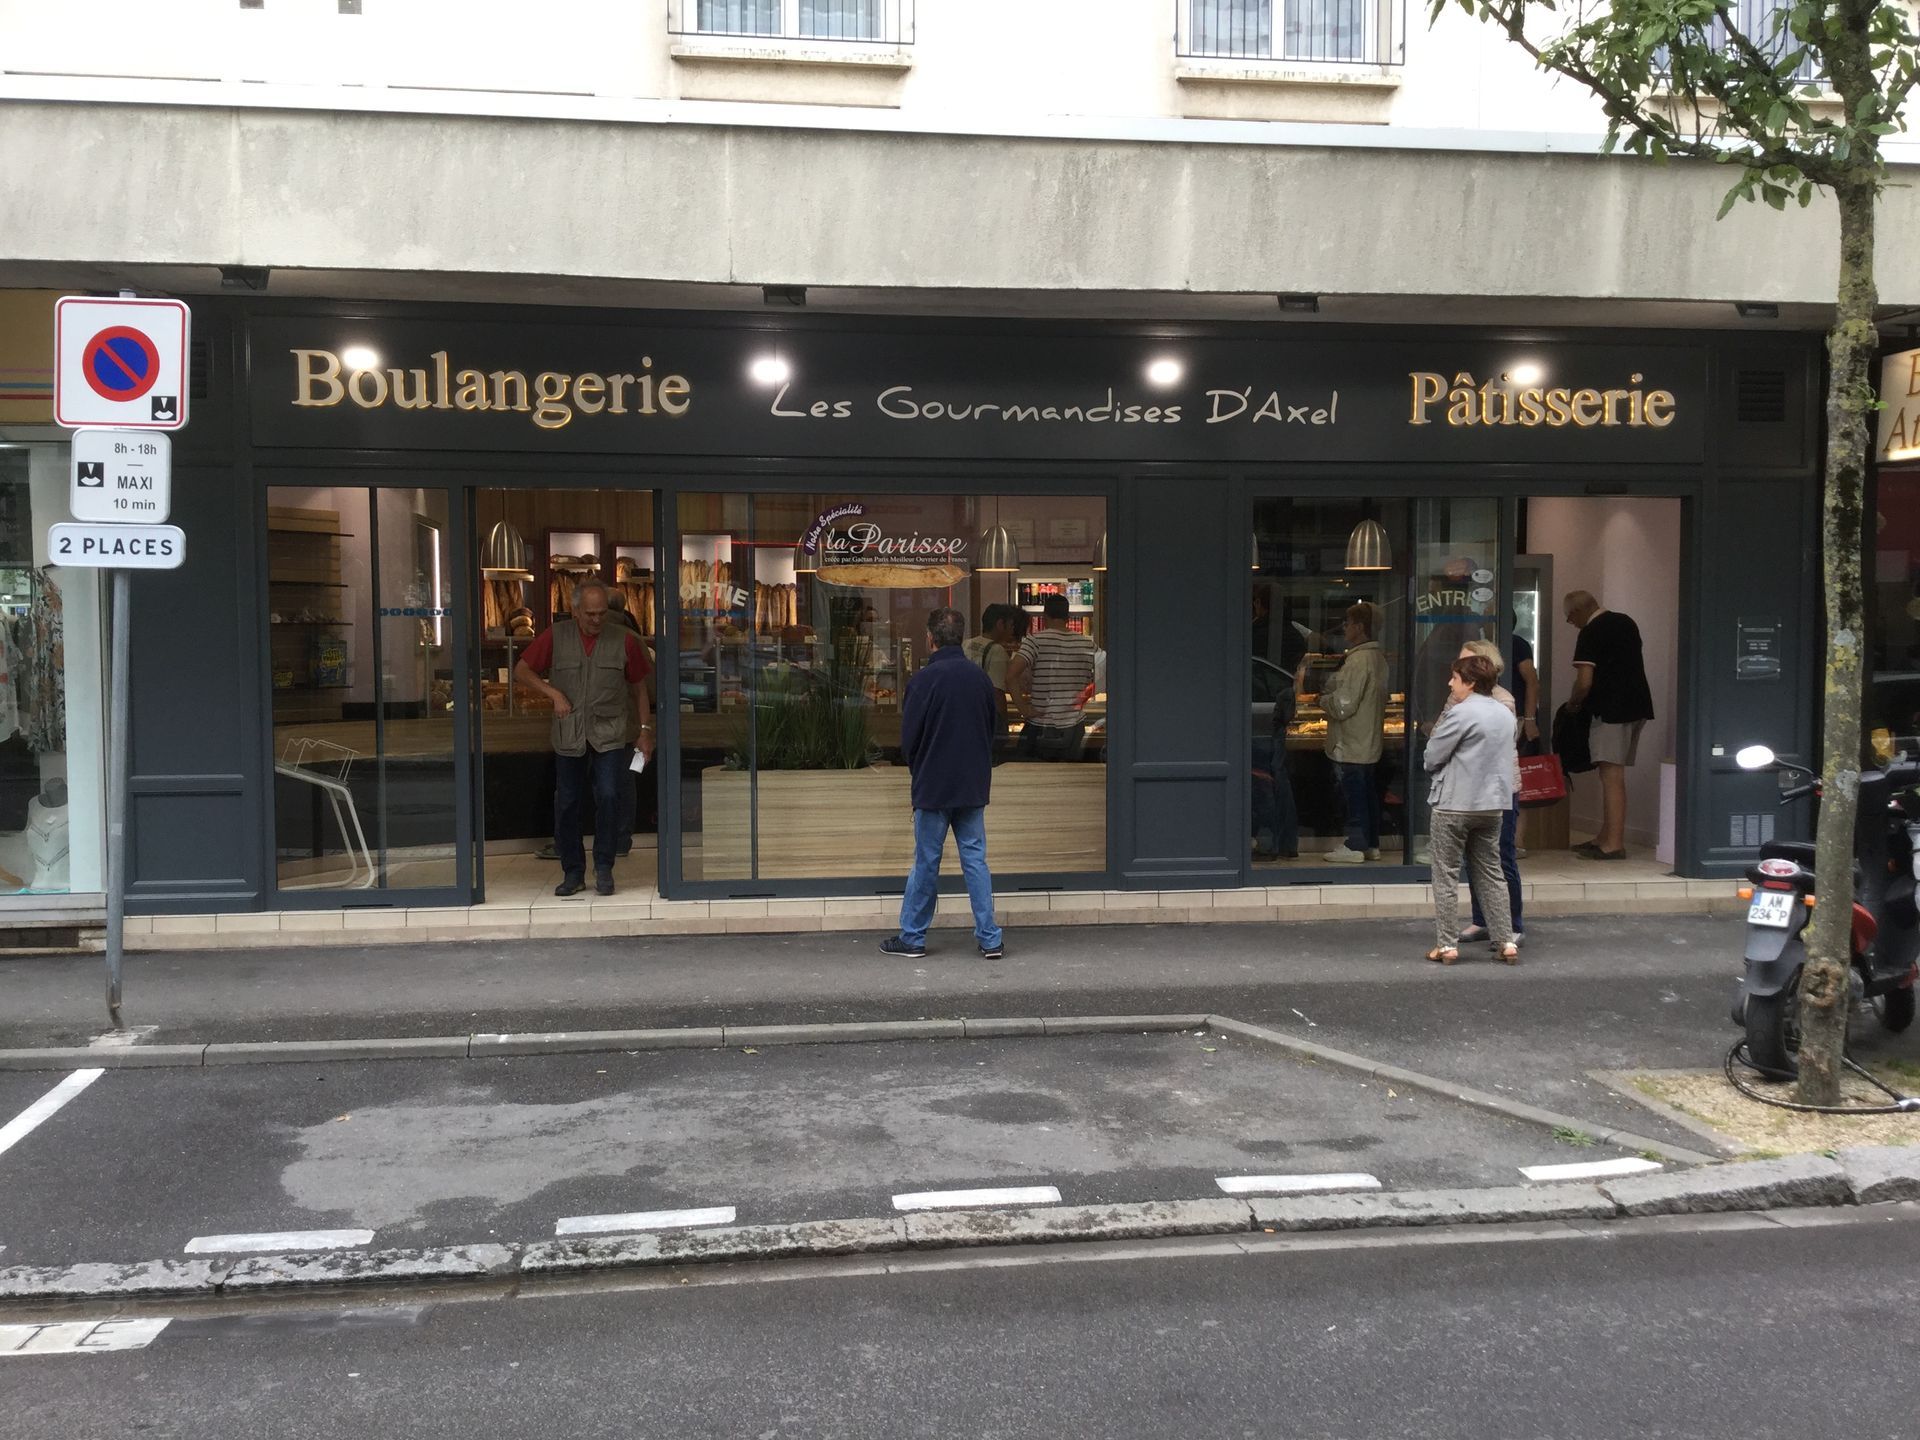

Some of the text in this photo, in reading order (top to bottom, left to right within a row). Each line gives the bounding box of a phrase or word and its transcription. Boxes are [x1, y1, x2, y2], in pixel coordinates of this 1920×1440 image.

[290, 349, 691, 428] Boulangerie
[1409, 372, 1676, 426] Pâtisserie
[770, 382, 1338, 426] Les Gourmandises D'Axel
[114, 443, 127, 454] 8h
[138, 443, 157, 455] 18h
[117, 476, 153, 490] MAXI
[113, 498, 156, 510] 10 min
[805, 503, 863, 551] Notre Spécialité
[848, 522, 968, 554] Parisse
[59, 537, 173, 556] 2 PLACES
[679, 581, 750, 607] ORTIE
[1416, 590, 1472, 612] ENTR
[1768, 896, 1784, 908] AM
